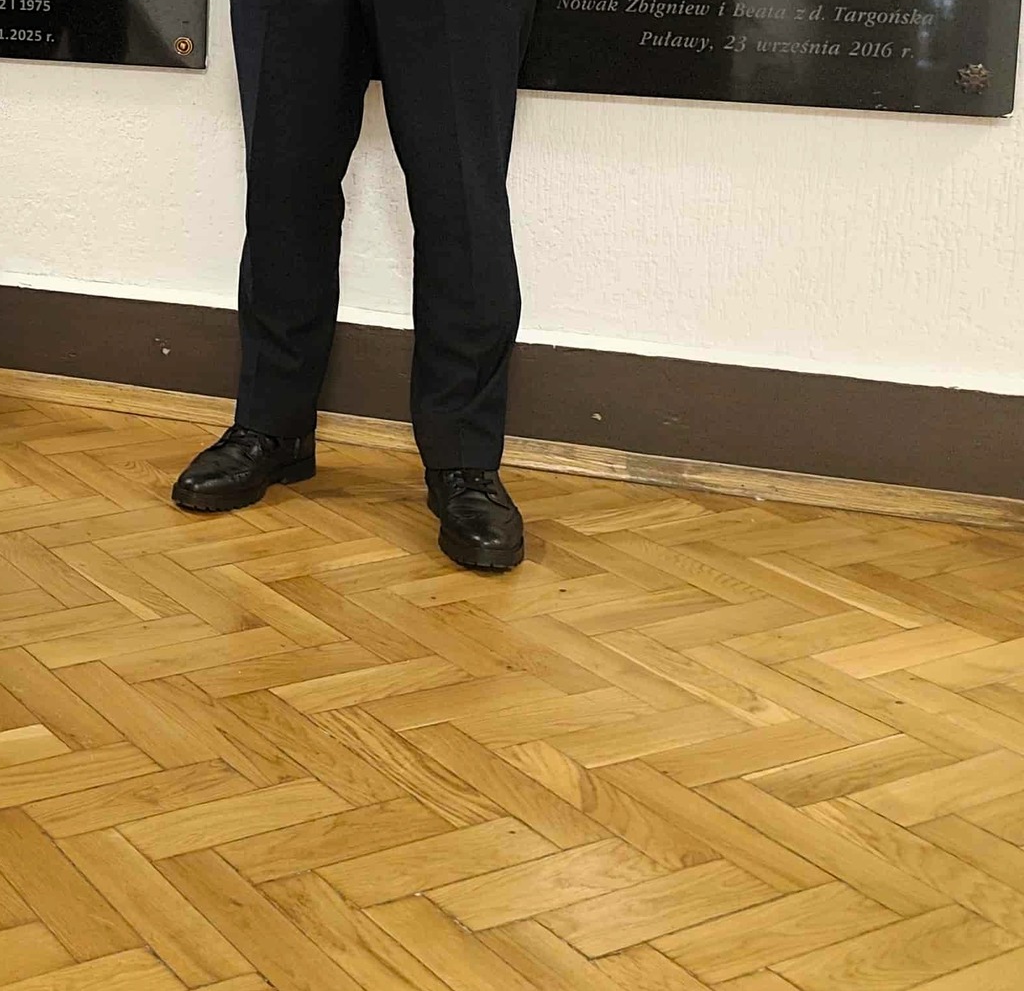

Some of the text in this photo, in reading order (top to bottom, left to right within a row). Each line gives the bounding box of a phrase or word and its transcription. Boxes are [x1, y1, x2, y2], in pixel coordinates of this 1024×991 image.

[19, 0, 51, 11] 1975
[834, 6, 935, 28] Targońska
[639, 31, 714, 52] Puławy,
[723, 35, 747, 53] 23
[756, 38, 841, 56] września
[848, 41, 895, 59] 2016
